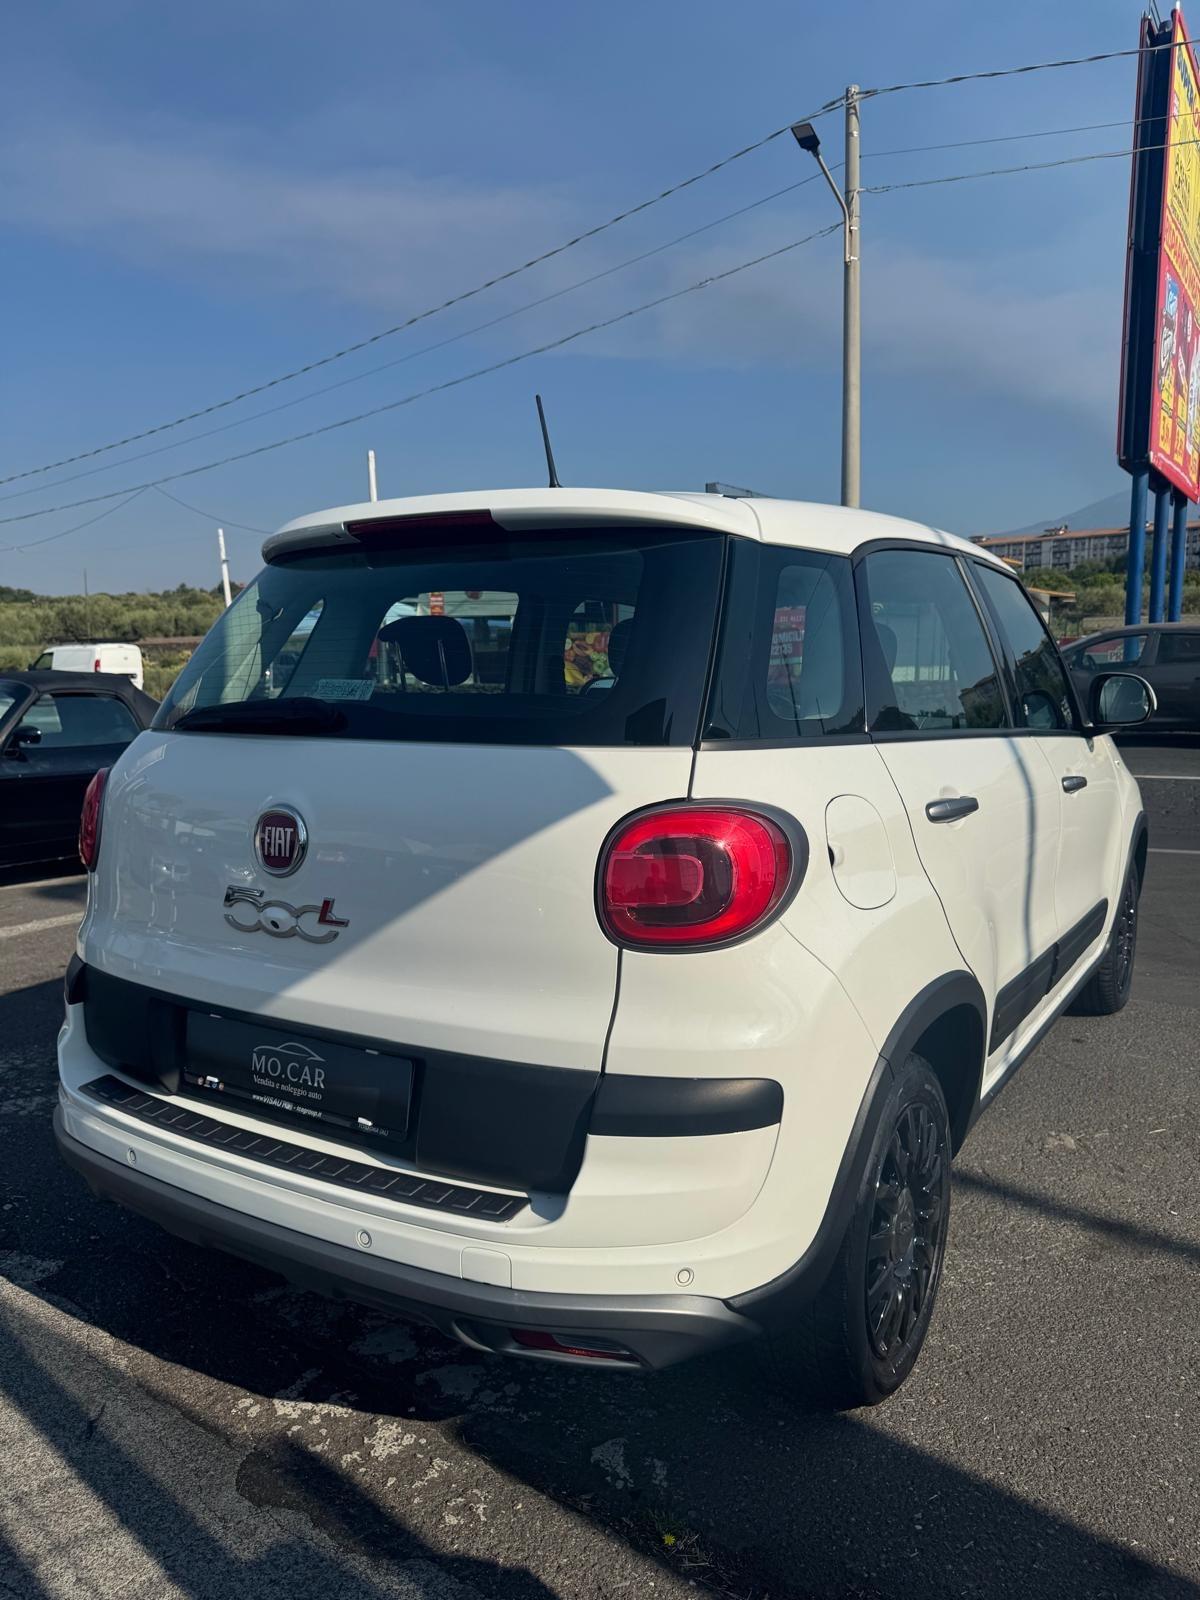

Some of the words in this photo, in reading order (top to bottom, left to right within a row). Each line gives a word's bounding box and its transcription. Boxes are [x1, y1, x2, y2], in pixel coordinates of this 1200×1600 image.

[264, 826, 294, 858] FIAT
[223, 884, 350, 944] 500L
[251, 1053, 326, 1089] MO.CAR
[253, 1074, 275, 1088] Vendita
[280, 1084, 308, 1097] noleggio
[307, 1091, 323, 1100] auto
